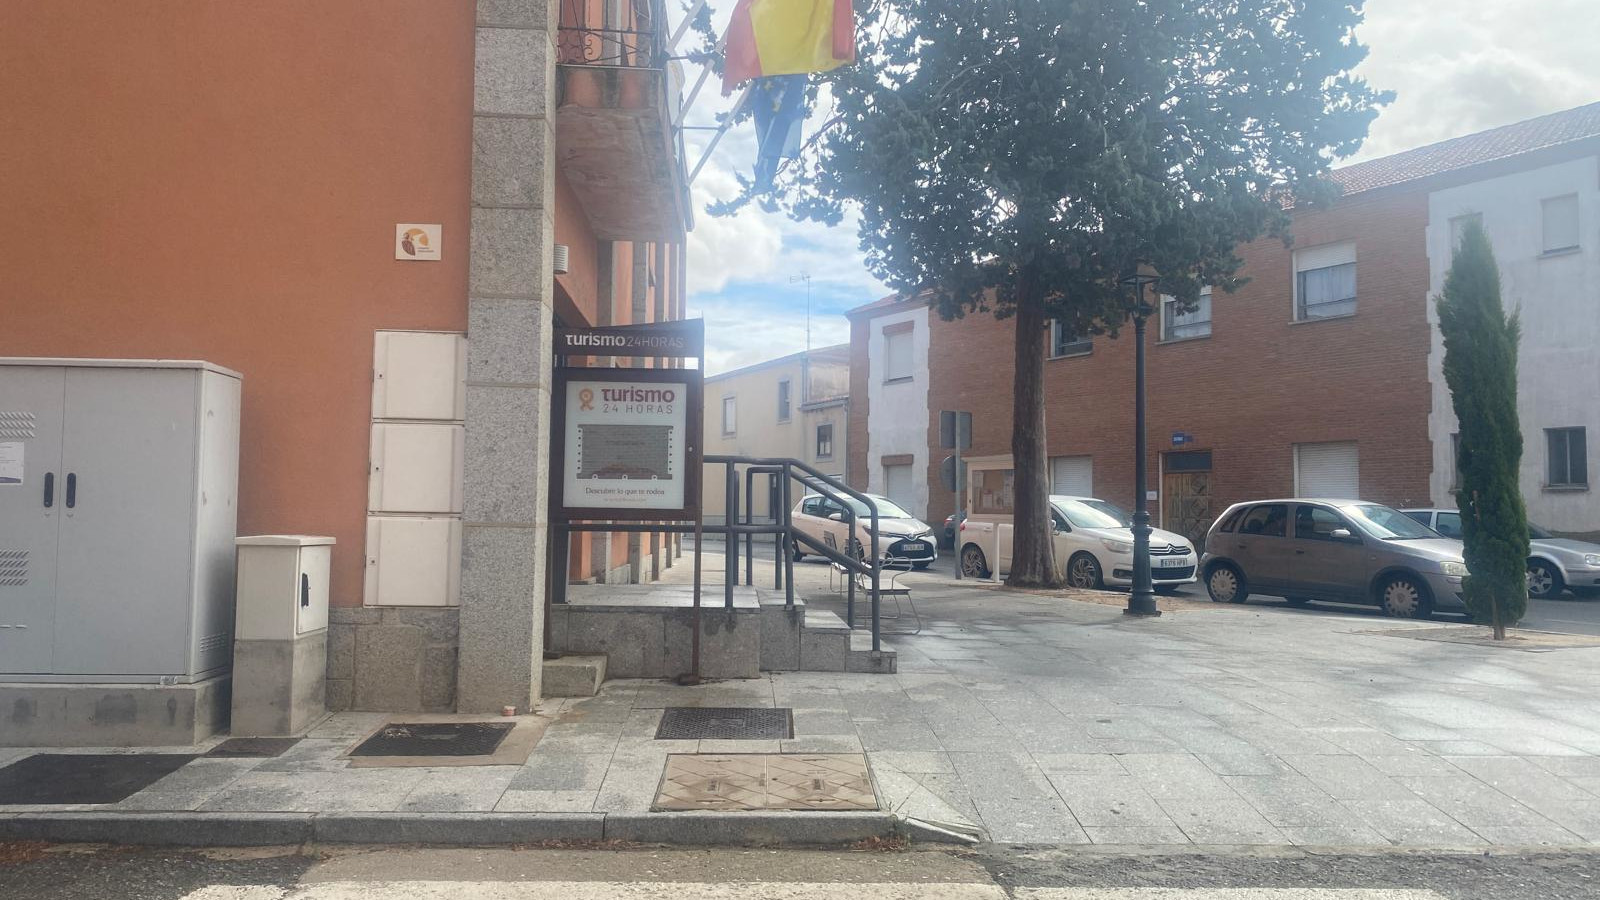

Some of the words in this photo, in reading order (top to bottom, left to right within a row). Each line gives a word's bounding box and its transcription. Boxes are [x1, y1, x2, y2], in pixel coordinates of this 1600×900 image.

[565, 332, 626, 347] turismo
[626, 335, 684, 348] 24HORAS
[601, 386, 675, 403] turismo
[603, 403, 618, 413] 24
[625, 404, 673, 415] HORAS
